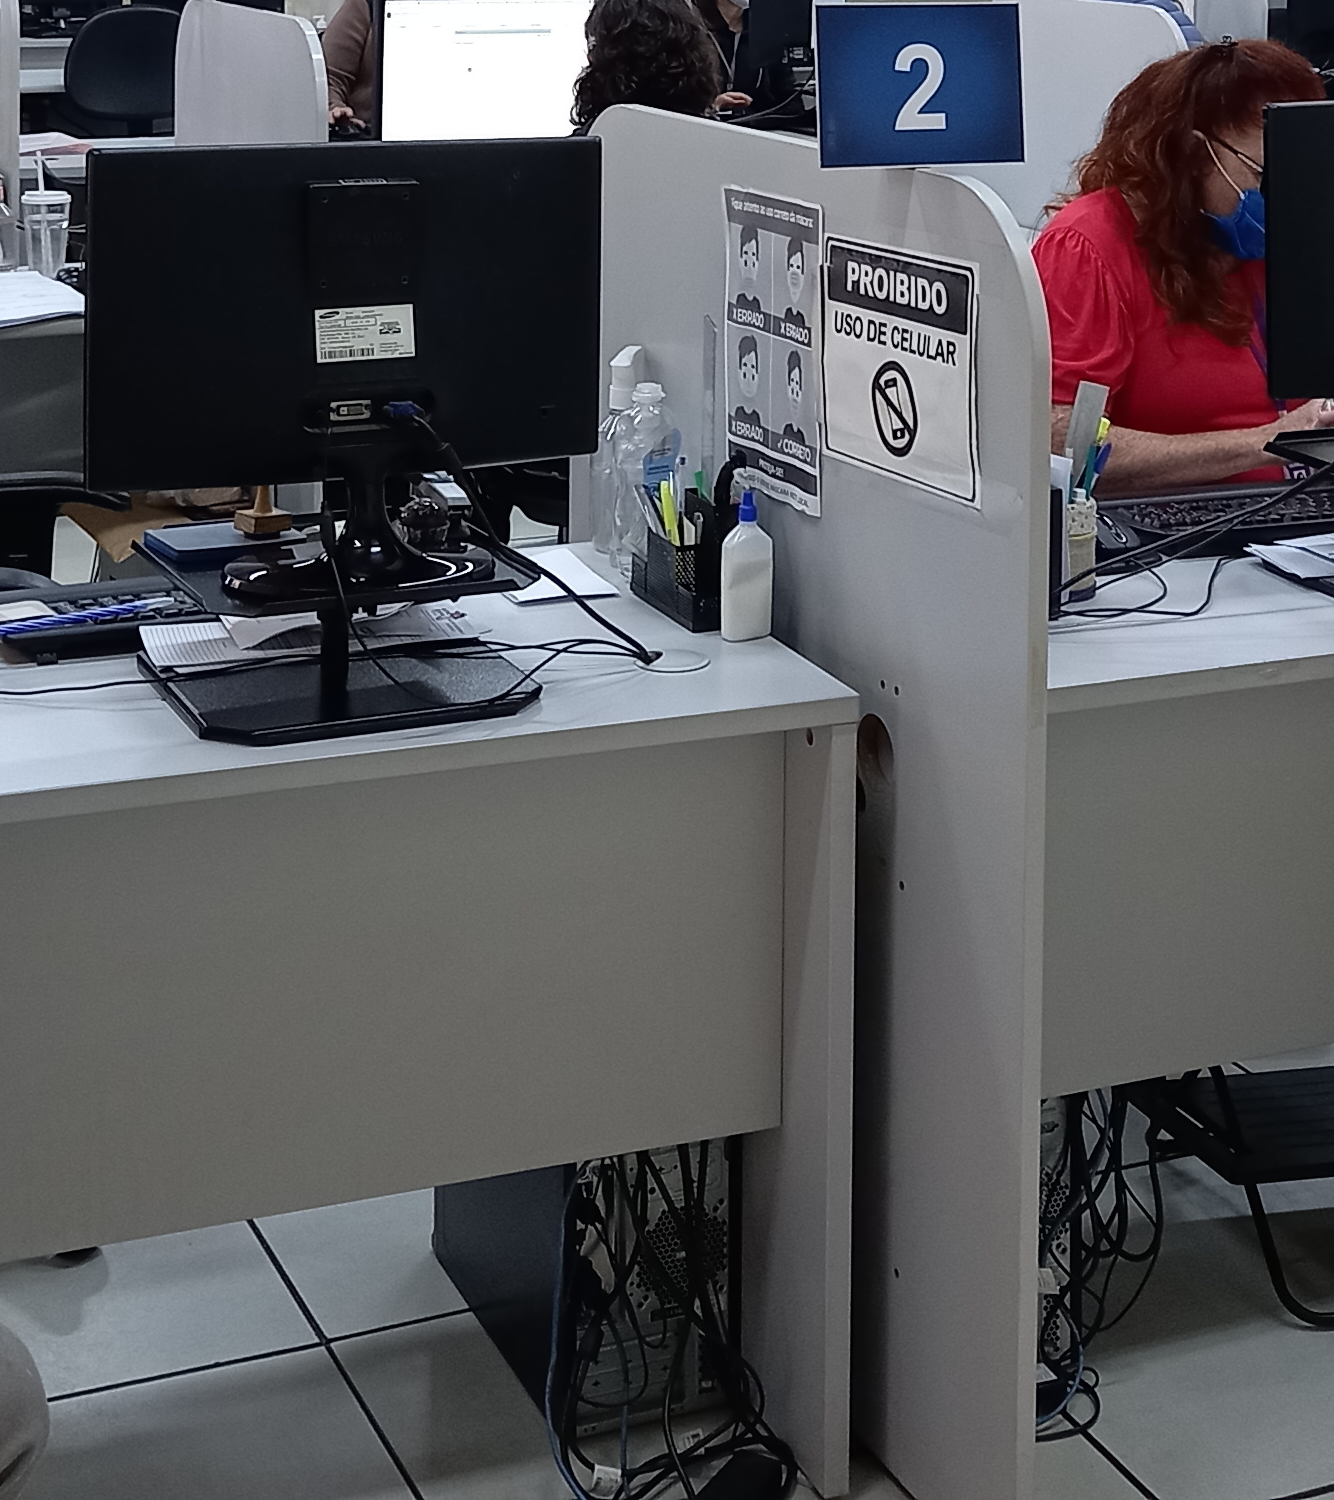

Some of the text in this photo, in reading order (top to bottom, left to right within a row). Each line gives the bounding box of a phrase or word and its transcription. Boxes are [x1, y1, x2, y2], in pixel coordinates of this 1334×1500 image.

[894, 42, 947, 131] 2
[845, 260, 948, 315] PROIBIDO
[737, 308, 765, 329] ERRADO
[785, 322, 810, 344] ERRADO
[833, 309, 958, 368] USO DE CELULAR
[736, 420, 764, 443] ERRADO
